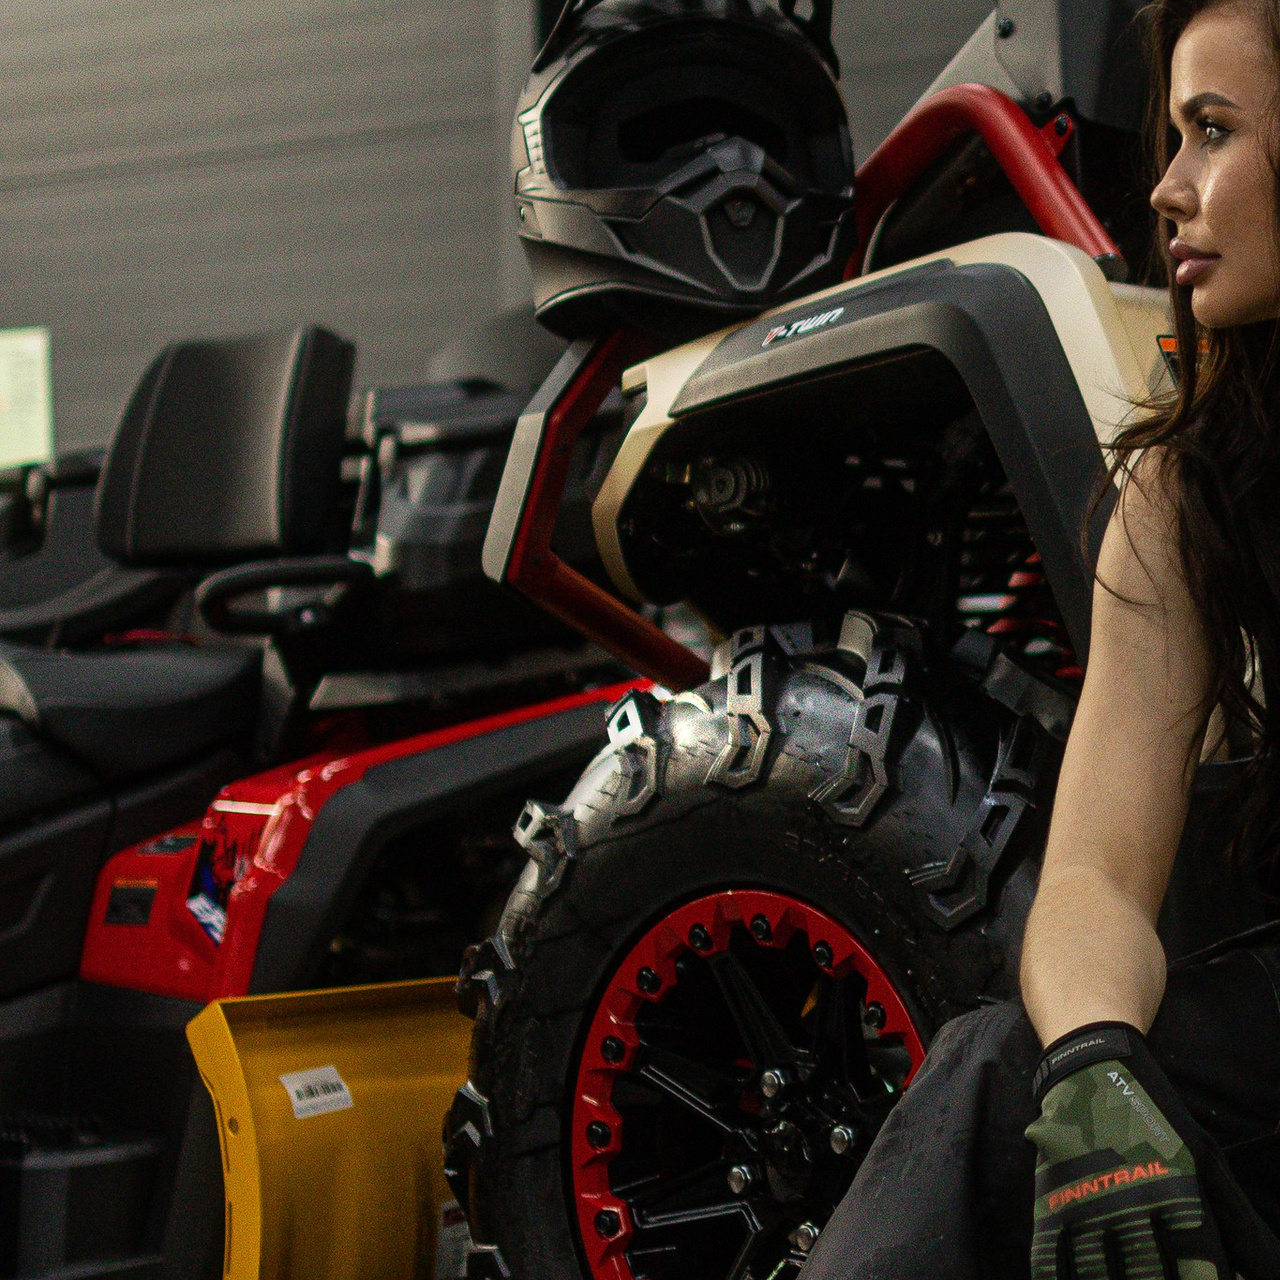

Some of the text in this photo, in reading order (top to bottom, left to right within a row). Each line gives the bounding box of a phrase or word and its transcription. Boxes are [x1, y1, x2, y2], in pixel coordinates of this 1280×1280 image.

[1051, 1037, 1106, 1065] FINNTRAIL
[1107, 1070, 1171, 1143] ATV SPORT
[1048, 1160, 1170, 1210] FINNTRAIL
